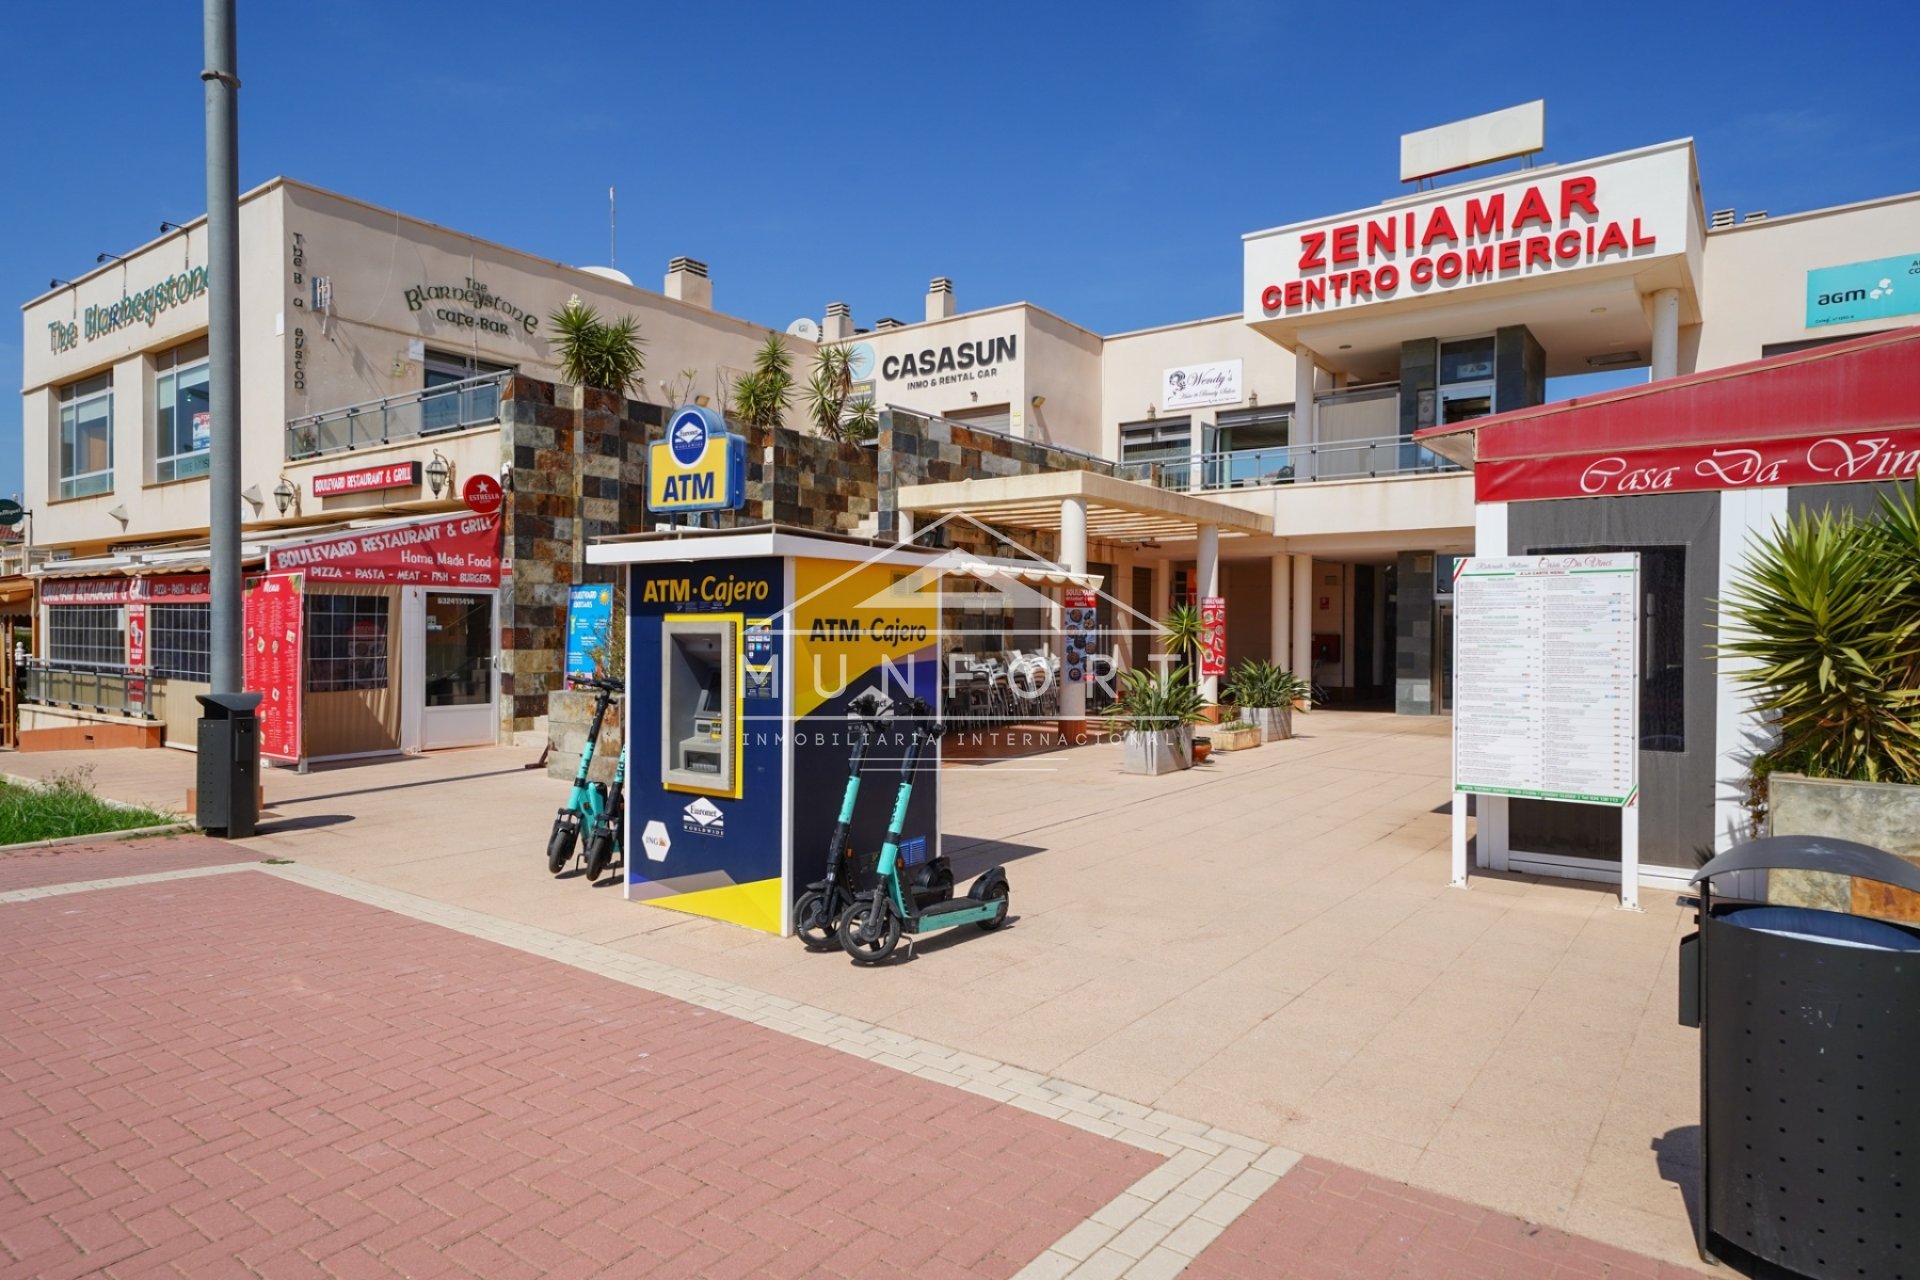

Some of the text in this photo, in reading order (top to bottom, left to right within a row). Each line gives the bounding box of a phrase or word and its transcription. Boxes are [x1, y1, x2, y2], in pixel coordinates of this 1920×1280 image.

[1298, 175, 1599, 270] ZENIAMAR
[1261, 217, 1657, 311] CENTRO COMERCIAL
[465, 277, 488, 292] The
[48, 320, 77, 353] The
[881, 334, 1017, 382] CASASUN
[907, 368, 998, 391] INMO & RENTAL CAR
[314, 462, 412, 493] BOULEVARD RESTAURANT & GRILL
[663, 471, 715, 502] ATM
[1579, 456, 1681, 494] Casa
[1694, 448, 1789, 485] Da
[468, 493, 500, 502] ESTRELLA
[276, 516, 494, 569] BOULEVARD RESTAURANT & GRILL
[401, 550, 492, 568] Home Made Food
[310, 566, 343, 578] PIZZA
[355, 567, 386, 580] PASTA
[397, 569, 420, 582] MEAT
[431, 571, 449, 582] FISH
[459, 572, 492, 584] BURGERS
[643, 578, 690, 603] ATM
[700, 574, 769, 607] Cajero
[809, 617, 928, 648] ATM Cajero
[689, 804, 717, 818] Euronet
